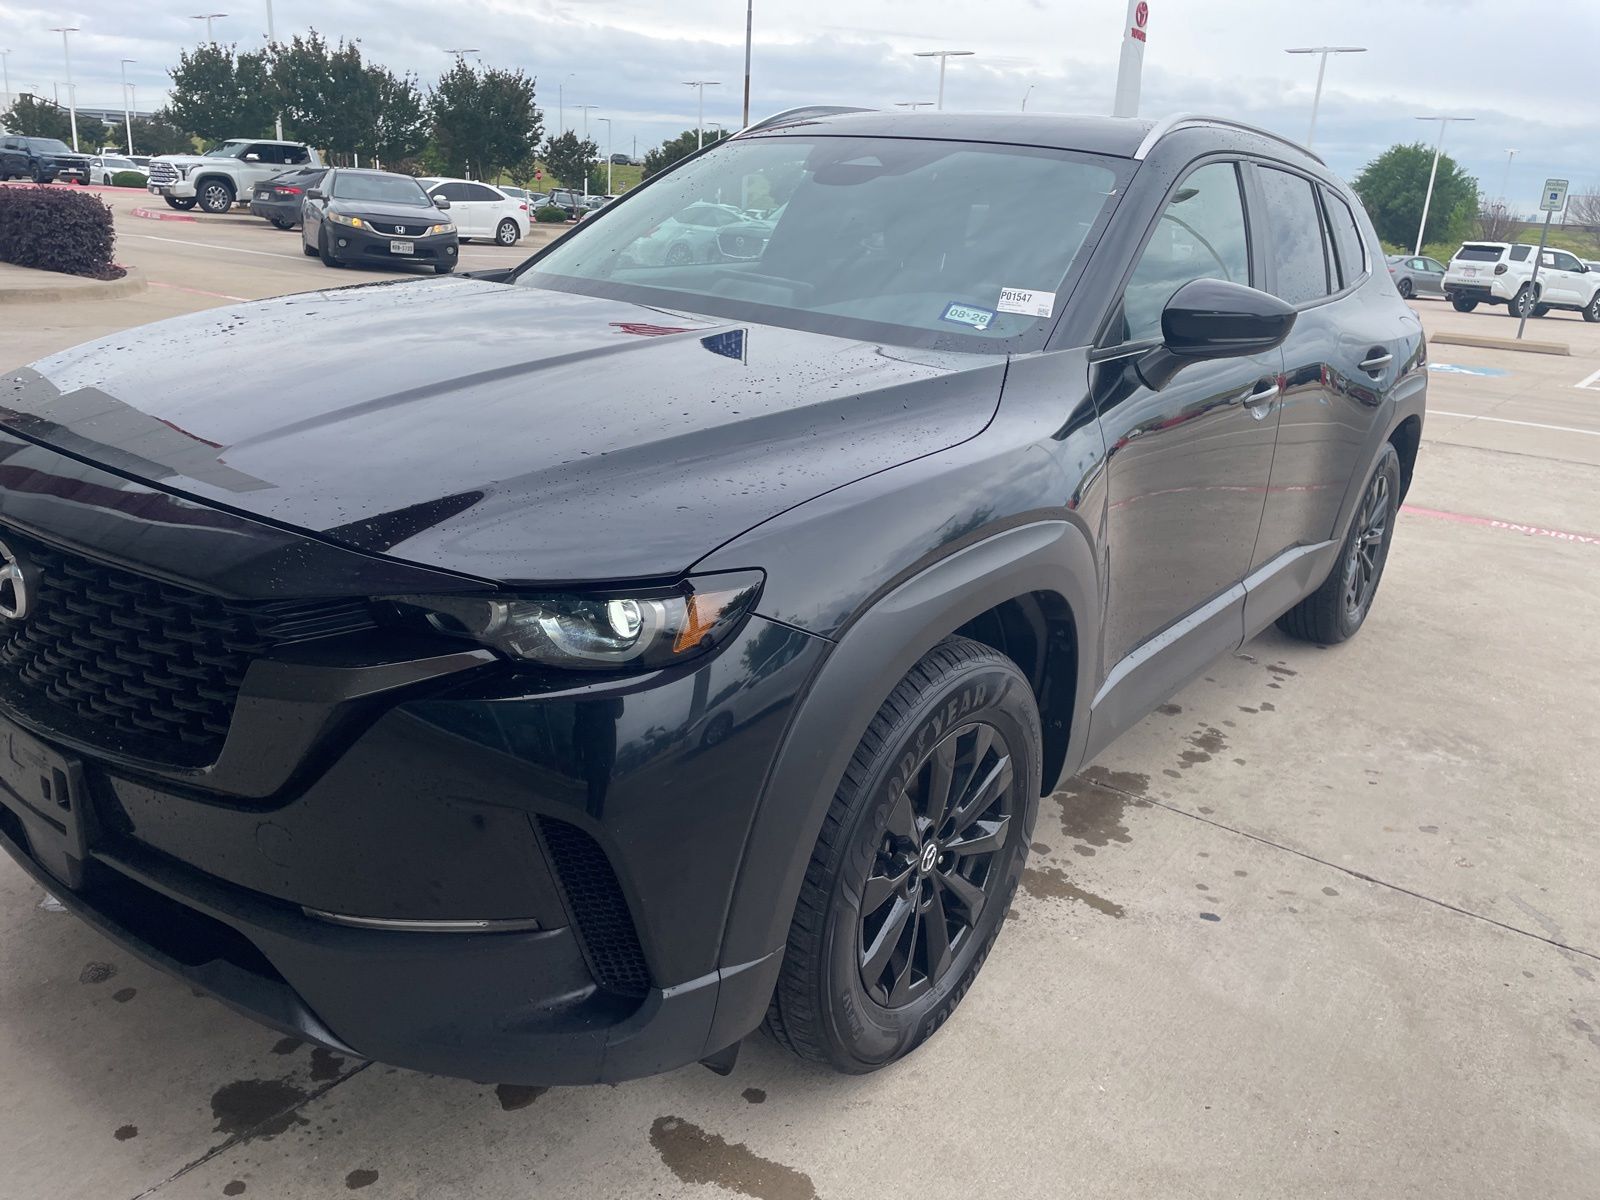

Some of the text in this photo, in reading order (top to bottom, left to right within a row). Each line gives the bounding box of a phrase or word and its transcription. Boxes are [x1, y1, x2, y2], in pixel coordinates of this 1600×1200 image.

[1000, 291, 1033, 303] P01547
[950, 308, 965, 319] 08
[970, 313, 988, 323] 26
[860, 682, 987, 859] GOODYEAR
